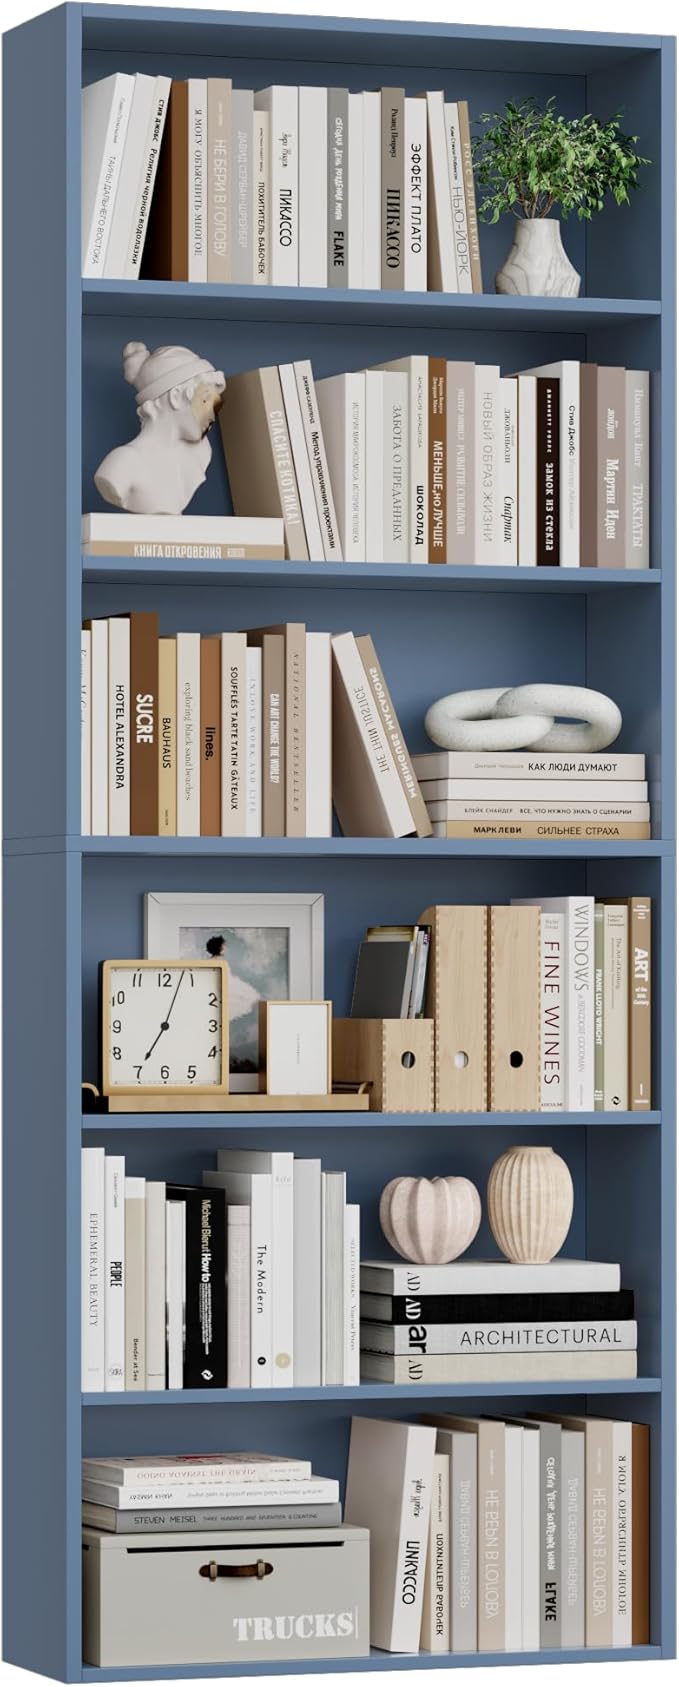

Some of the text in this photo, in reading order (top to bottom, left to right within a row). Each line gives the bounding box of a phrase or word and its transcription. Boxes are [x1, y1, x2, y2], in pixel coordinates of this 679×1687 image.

[410, 143, 422, 254] ЭФФЕКТ ПЛАТО
[279, 189, 292, 246] ПИКАССО
[386, 187, 401, 268] ПИКАССО
[452, 187, 469, 276] НЬЮ-ЙОРК
[333, 230, 345, 267] FLAKE
[391, 405, 402, 450] ЗАБОТА
[482, 392, 493, 440] НОВЫЙ
[567, 405, 575, 426] Стив
[567, 427, 575, 456] Джобс
[482, 445, 493, 488] ОБРАЗ
[415, 485, 425, 545] ШОКОЛАД
[501, 496, 514, 543] Спартак
[134, 544, 163, 558] КНИГА
[184, 682, 193, 722] exploring
[136, 694, 154, 744] SUCRE
[231, 711, 239, 739] TARTE
[115, 684, 125, 790] HOTEL ALEXANDRA
[162, 717, 171, 769] BAUHAUS
[185, 723, 193, 746] black
[205, 727, 216, 761] lines.
[185, 747, 193, 766] sand
[231, 740, 239, 767] TATIN
[528, 763, 546, 771] КАК
[548, 763, 576, 772] ЛЮДИ
[578, 763, 618, 772] ДУМАЮТ
[473, 826, 620, 835] МАРК ЛЕВИ СИЛЬНЕЕ СТРАХА
[574, 904, 589, 991] WINDOWS
[544, 941, 561, 994] FINE
[634, 947, 649, 982] ART
[132, 973, 142, 988] 11
[158, 973, 173, 987] 12
[112, 990, 125, 1007] 10
[207, 992, 218, 1008] 2
[112, 1019, 122, 1034] 9
[208, 1019, 218, 1033] 3
[112, 1046, 122, 1061] 8
[207, 1046, 218, 1059] 4
[544, 1005, 561, 1086] WINES
[132, 1065, 143, 1080] 7
[160, 1065, 170, 1080] 6
[186, 1065, 197, 1080] 5
[201, 1199, 211, 1228] Michael
[89, 1213, 98, 1328] EPHEMERAL BEAUTY
[109, 1261, 122, 1288] PEOPLE
[201, 1253, 211, 1271] How
[201, 1272, 211, 1282] to
[256, 1244, 267, 1314] The Modern
[459, 1328, 622, 1346] ARCHITECTURAL
[134, 1516, 165, 1524] STEVEN
[233, 1612, 354, 1642] TRUCKS
